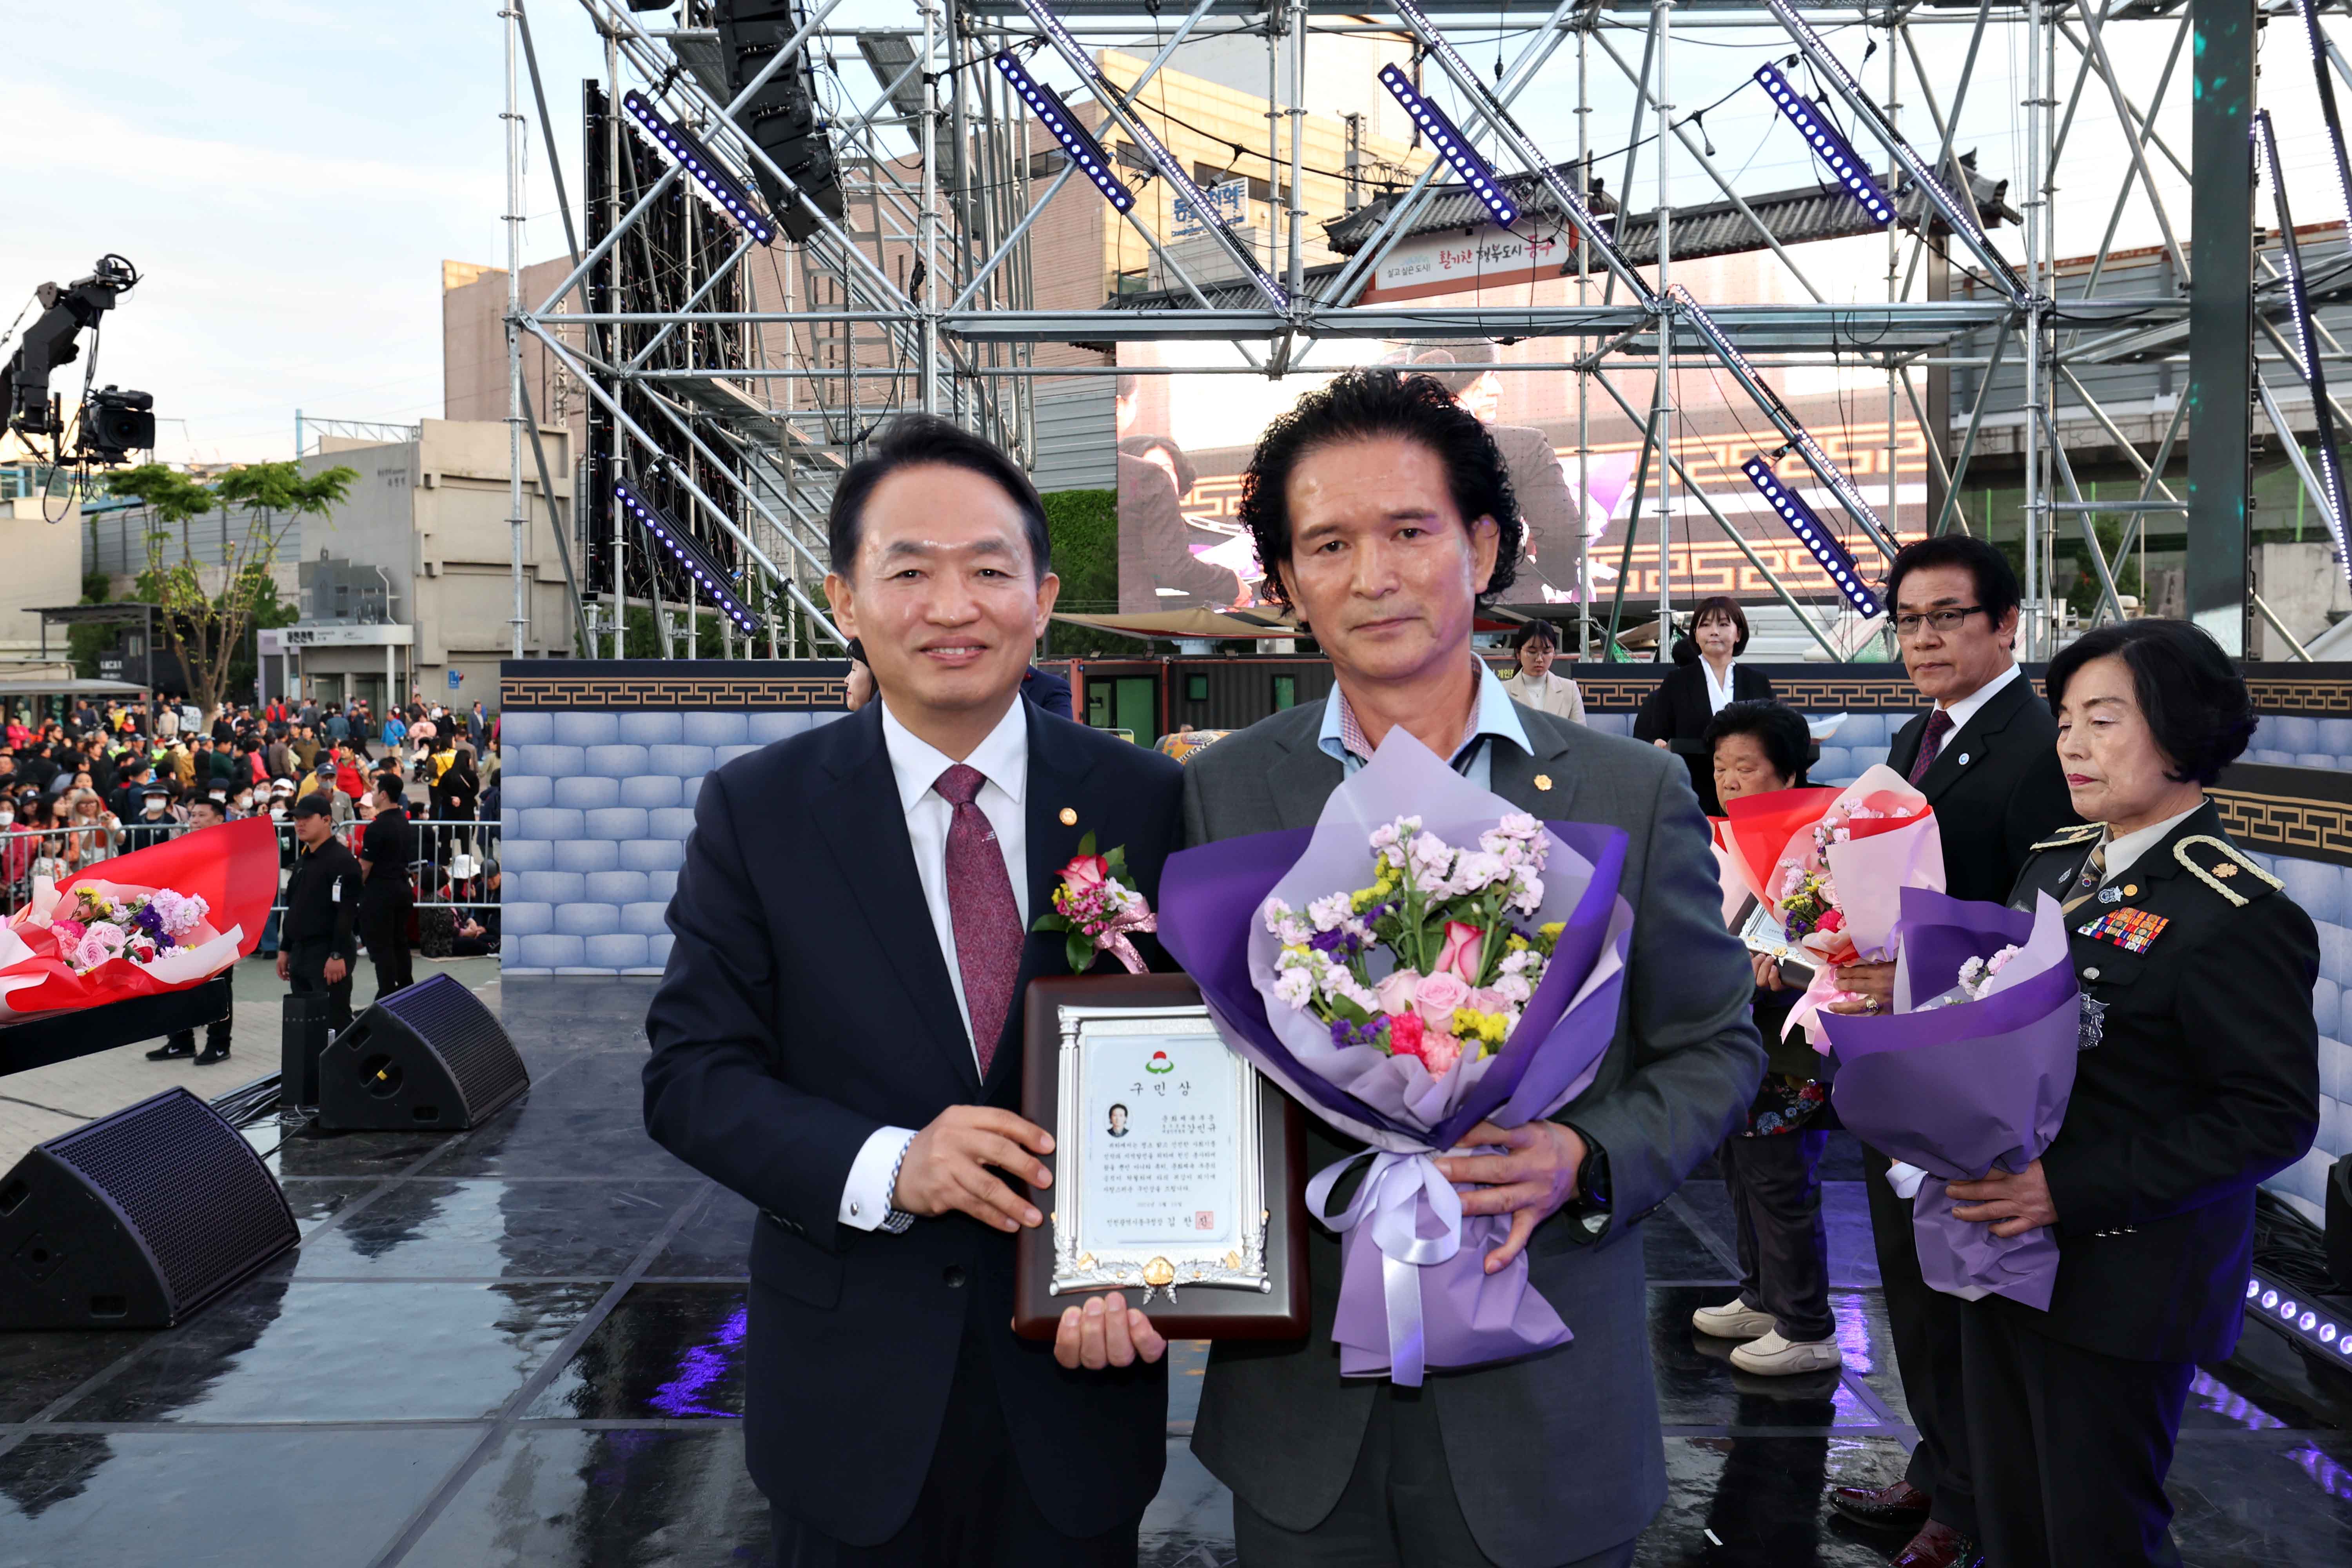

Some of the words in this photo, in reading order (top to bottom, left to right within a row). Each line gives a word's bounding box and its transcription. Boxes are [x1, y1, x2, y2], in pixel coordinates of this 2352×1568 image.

[1439, 249, 1473, 269] 활기찬
[1476, 243, 1522, 263] 행복도시
[1524, 234, 1556, 259] 동구
[1402, 266, 1414, 276] 싶은
